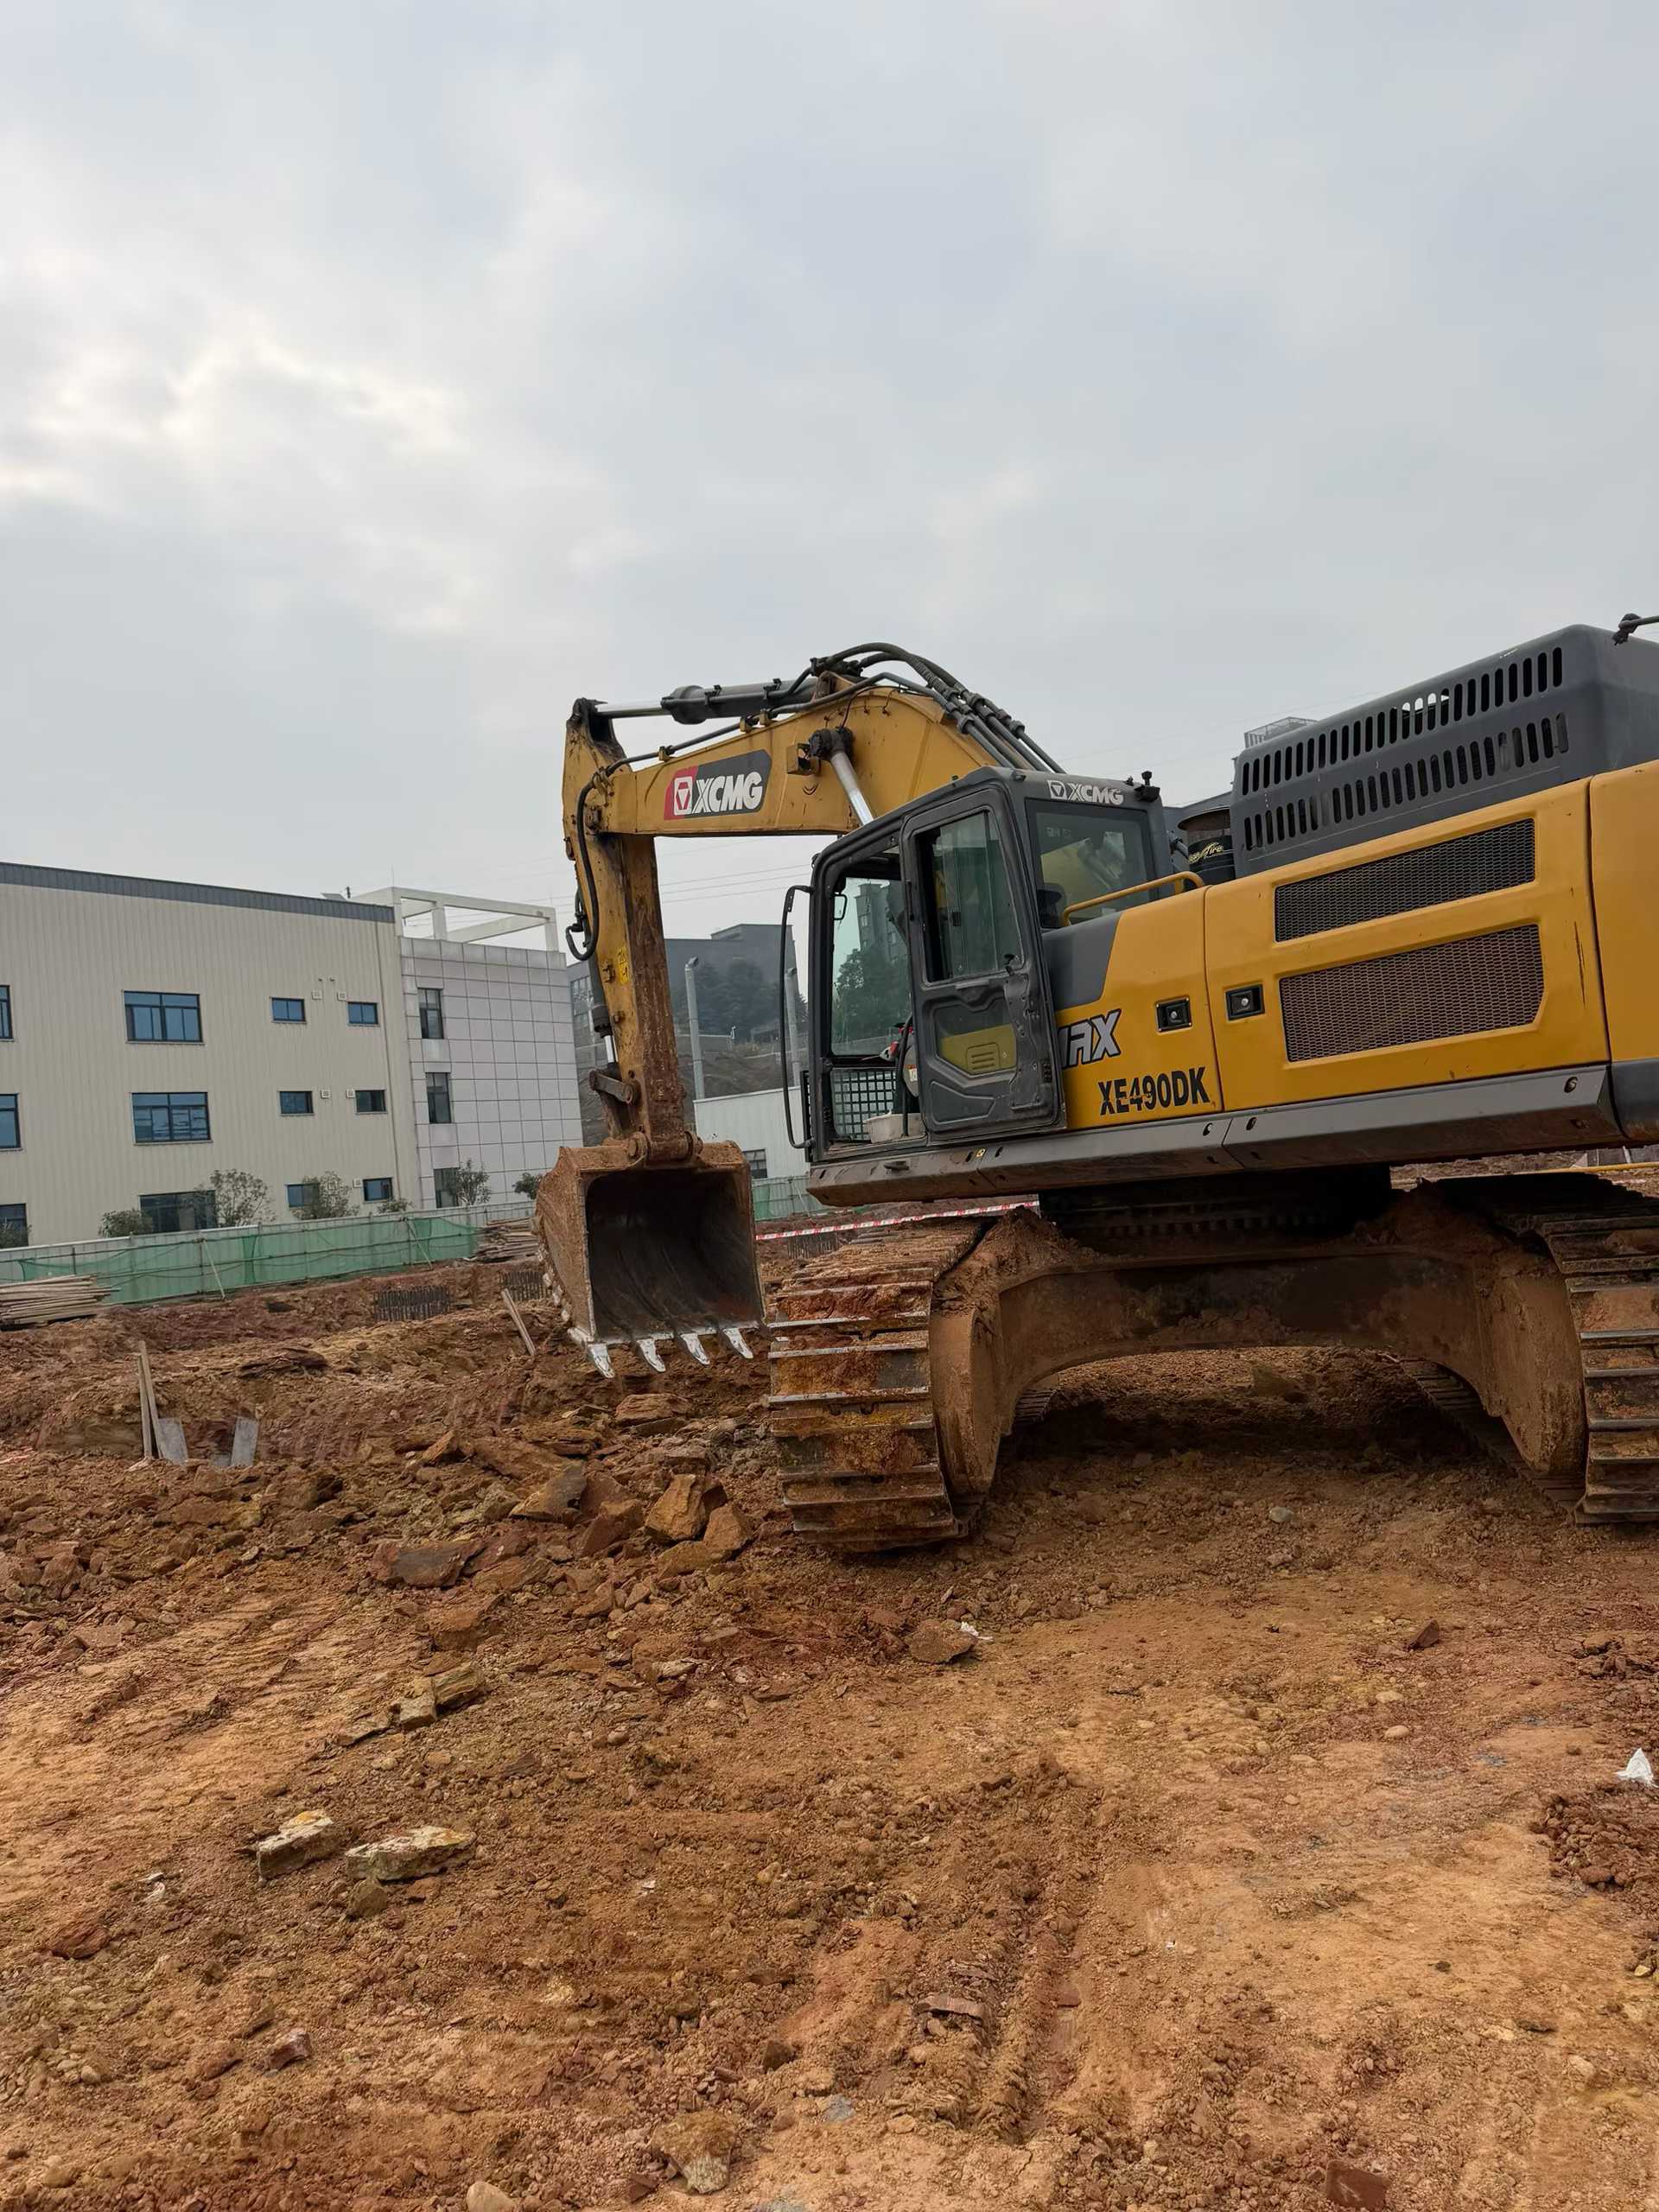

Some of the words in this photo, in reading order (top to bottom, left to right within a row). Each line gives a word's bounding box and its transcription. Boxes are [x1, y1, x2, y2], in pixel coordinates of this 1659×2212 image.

[692, 772, 762, 813] XCMG
[1067, 782, 1123, 805] XCMG
[1098, 1066, 1211, 1116] XE490DK
